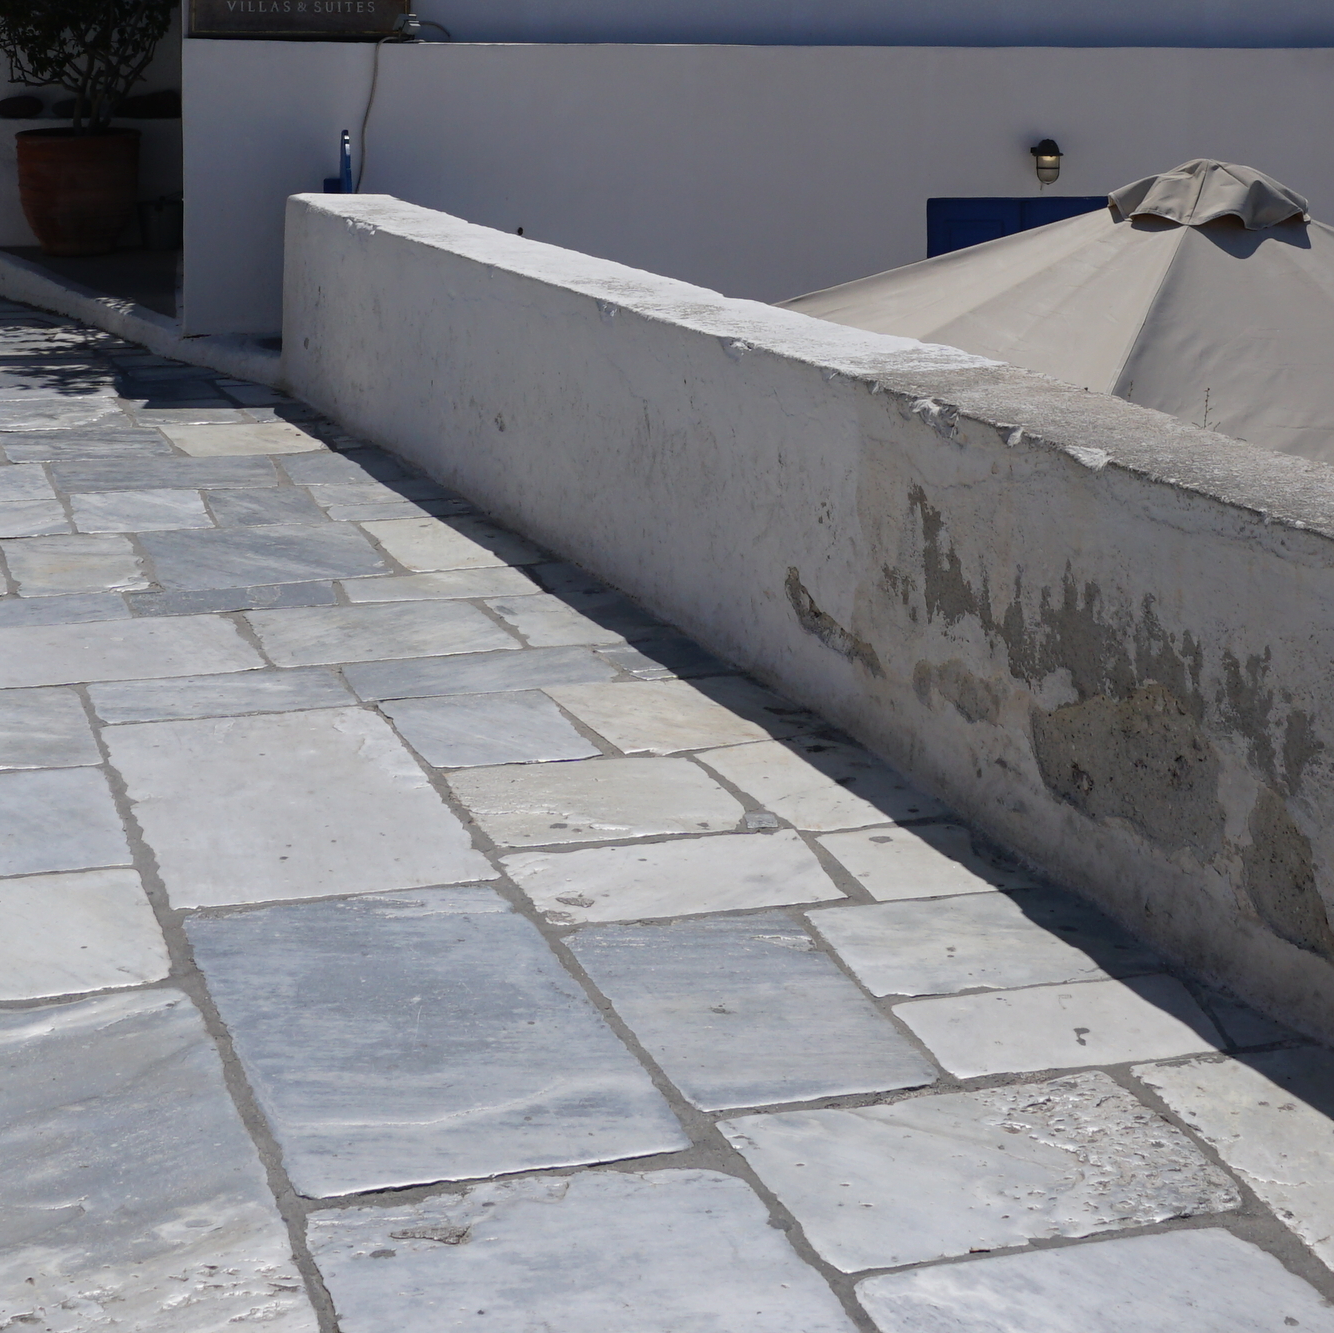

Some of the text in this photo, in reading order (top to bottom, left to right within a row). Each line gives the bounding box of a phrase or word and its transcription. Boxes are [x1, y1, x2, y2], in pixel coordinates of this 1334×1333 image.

[226, 0, 376, 13] VILLAS & SUITES
